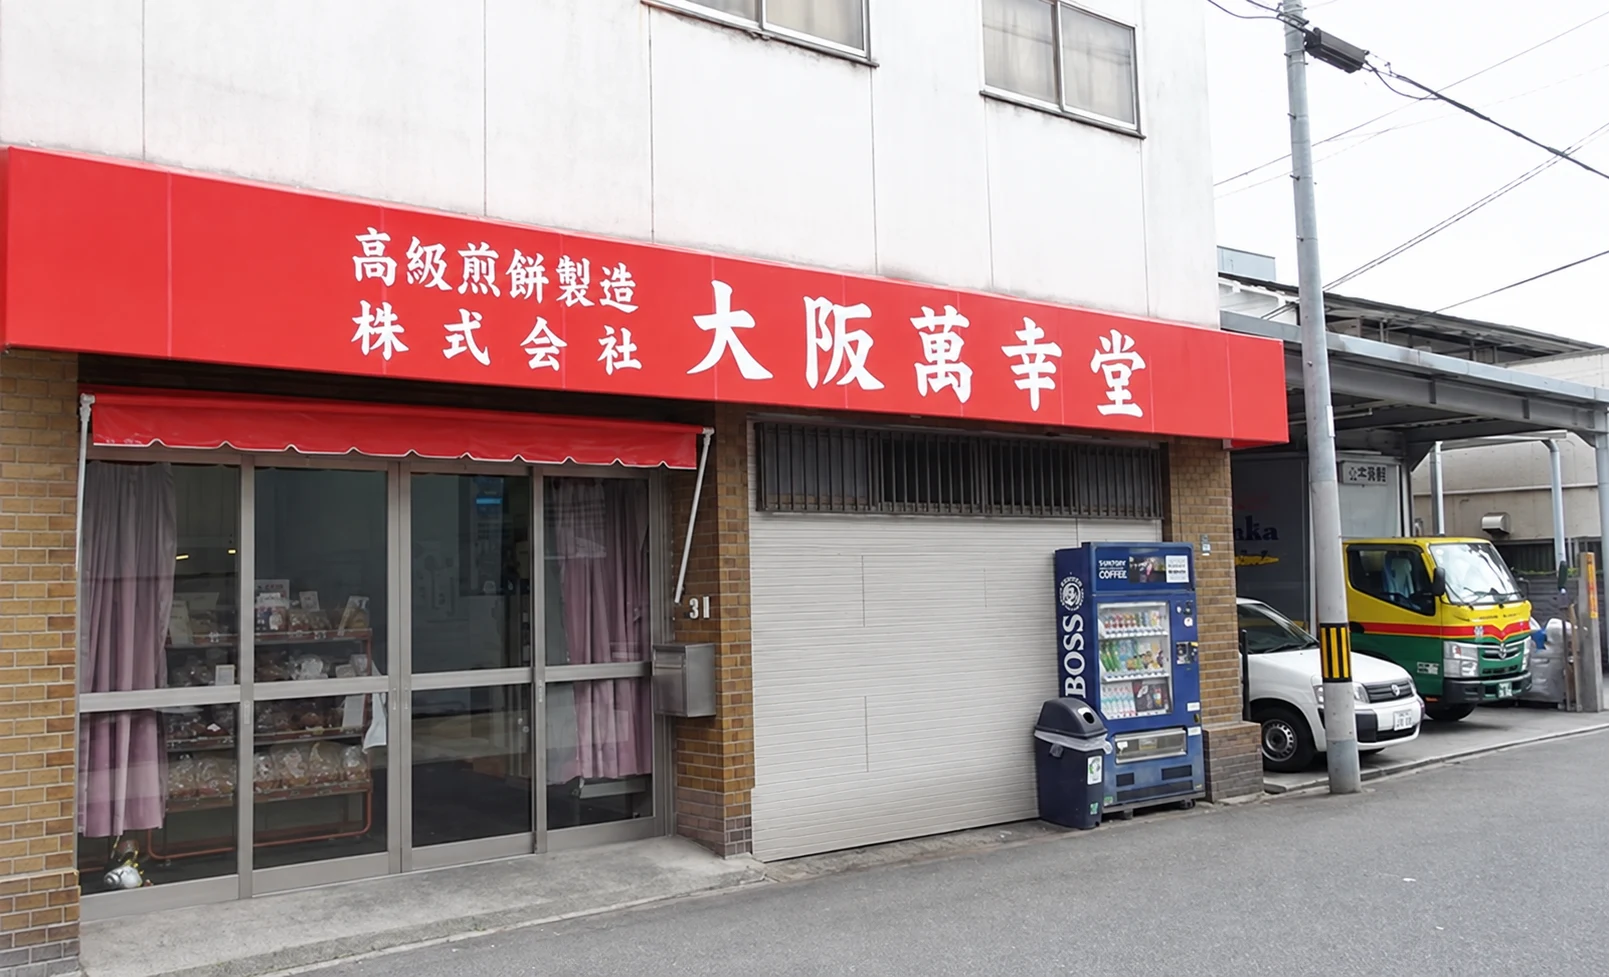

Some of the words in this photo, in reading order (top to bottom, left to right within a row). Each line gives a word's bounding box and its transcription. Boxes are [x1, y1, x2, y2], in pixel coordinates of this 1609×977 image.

[352, 226, 639, 314] 高級煎餅製造
[351, 299, 643, 376] 株式会社
[686, 279, 1146, 418] 大阪萬幸堂
[689, 596, 710, 619] 31
[1098, 570, 1128, 579] COFFEE
[1062, 613, 1086, 699] BOSS
